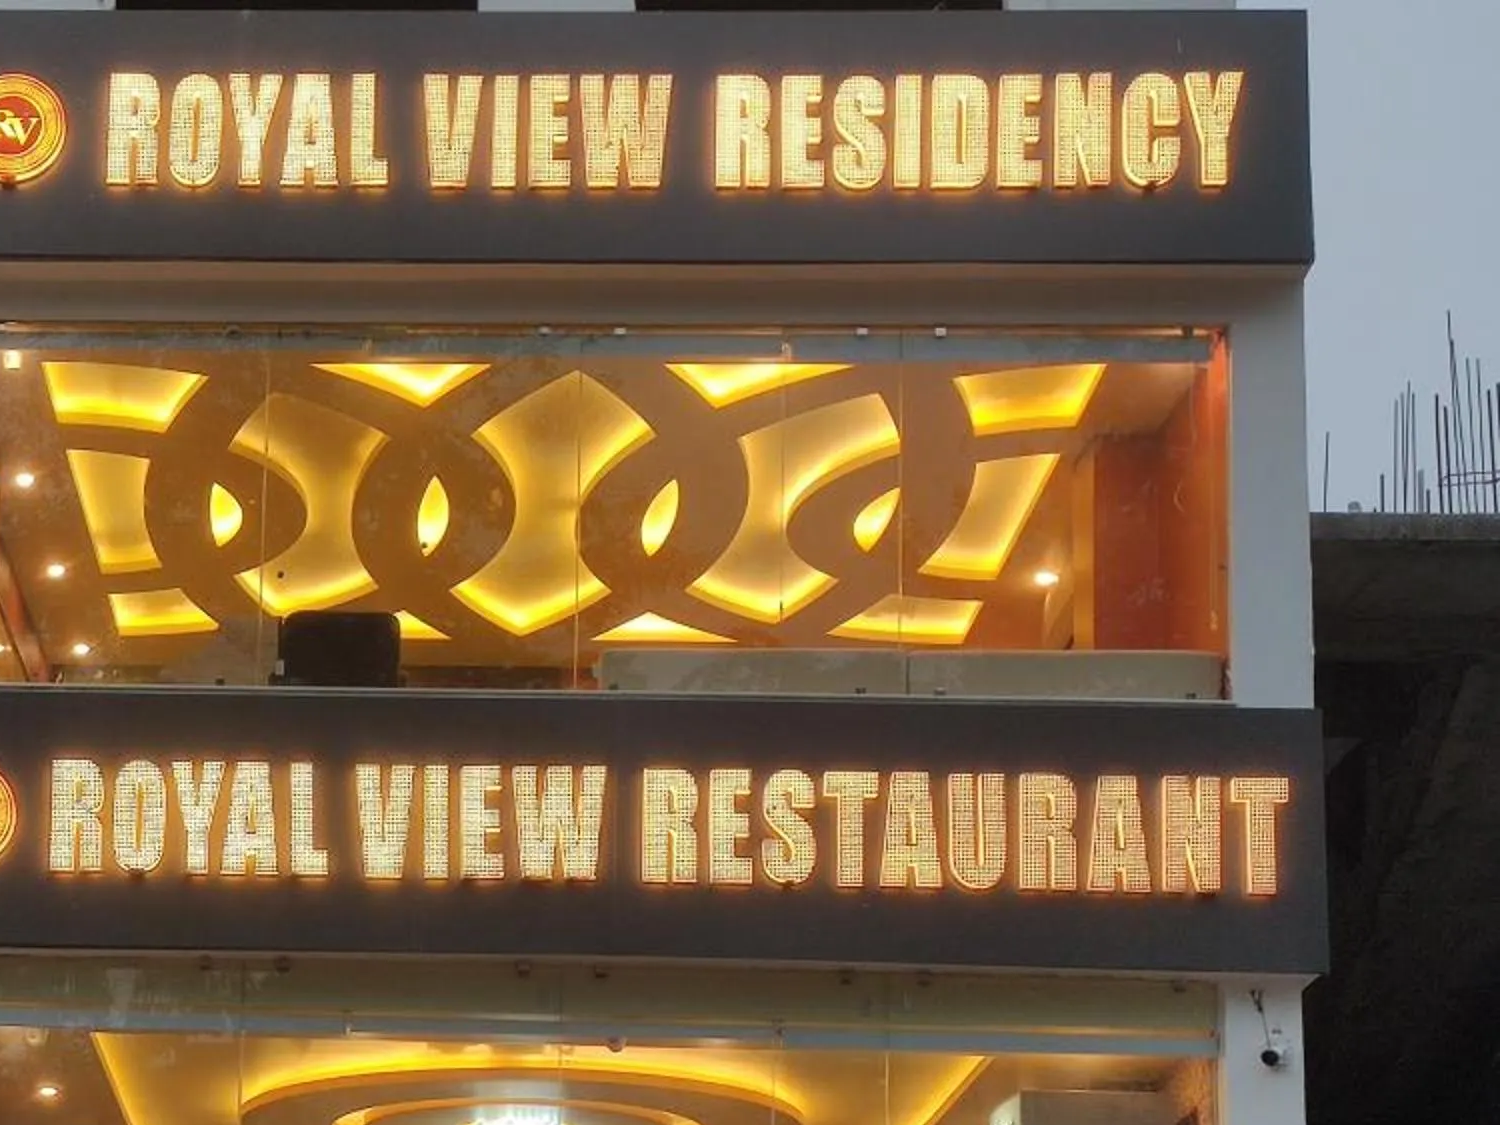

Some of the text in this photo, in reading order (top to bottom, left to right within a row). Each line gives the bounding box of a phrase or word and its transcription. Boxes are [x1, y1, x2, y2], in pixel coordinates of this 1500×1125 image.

[104, 71, 1244, 191] ROYAL VIEW RESIDENCY
[47, 758, 1290, 896] ROYAL VIEW RESTAURANT
